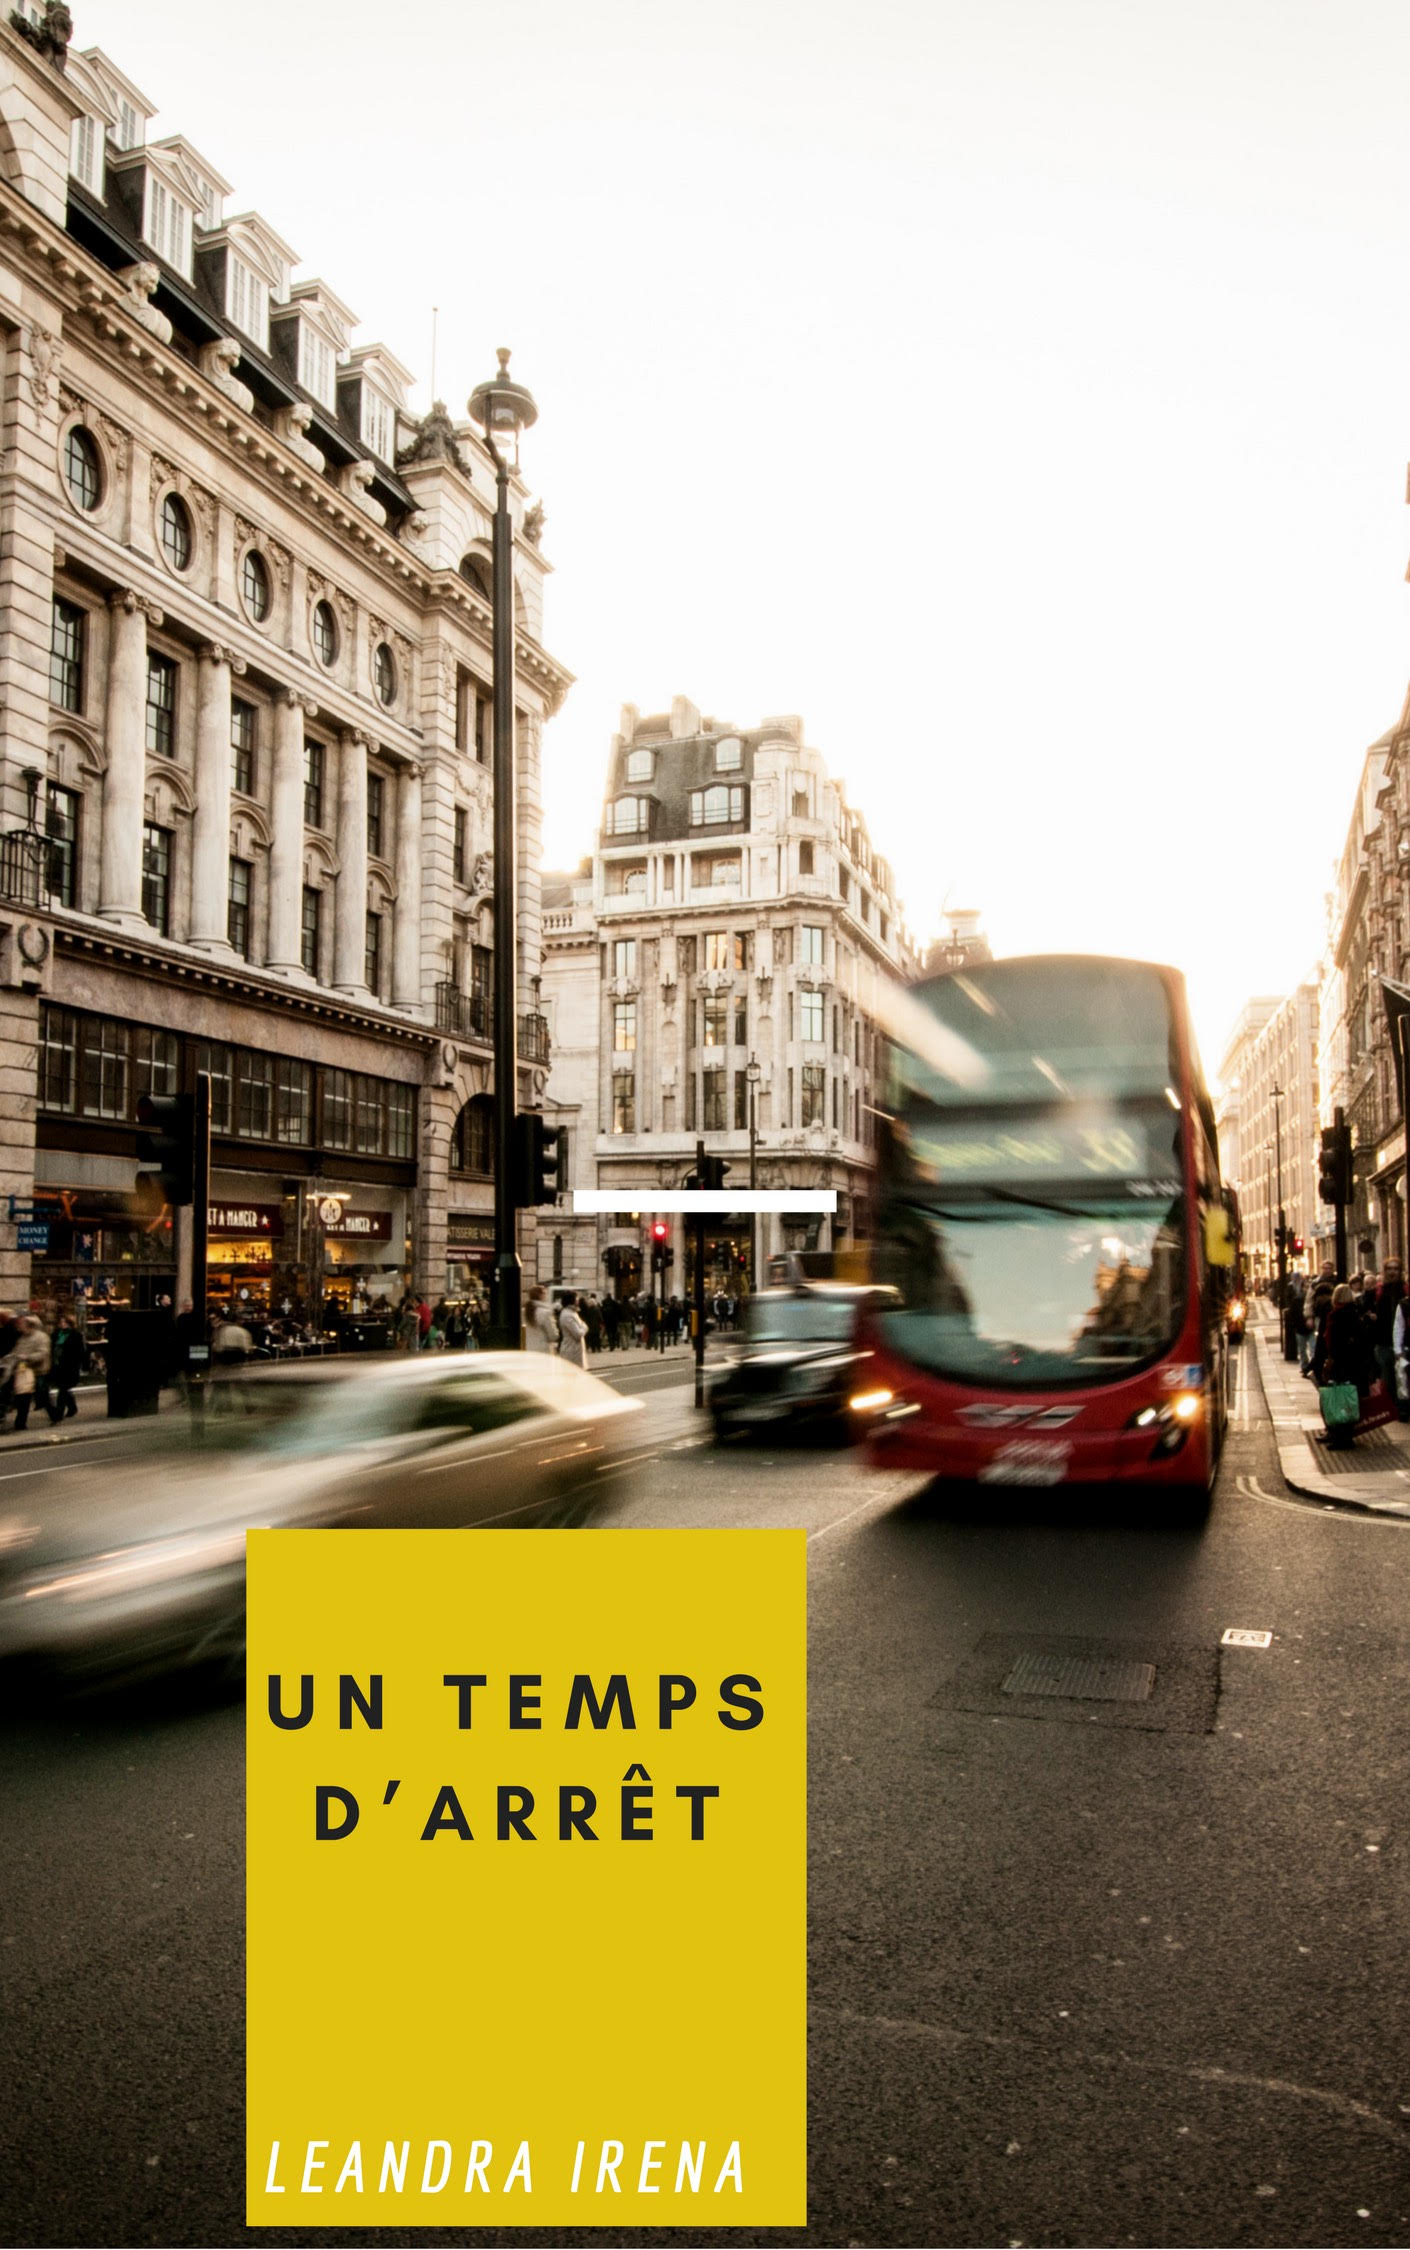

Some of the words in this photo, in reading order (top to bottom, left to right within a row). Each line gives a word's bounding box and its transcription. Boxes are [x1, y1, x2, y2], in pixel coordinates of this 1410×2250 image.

[226, 1209, 258, 1228] MANGER
[19, 1226, 49, 1235] MONEY
[18, 1236, 49, 1245] CHANGE
